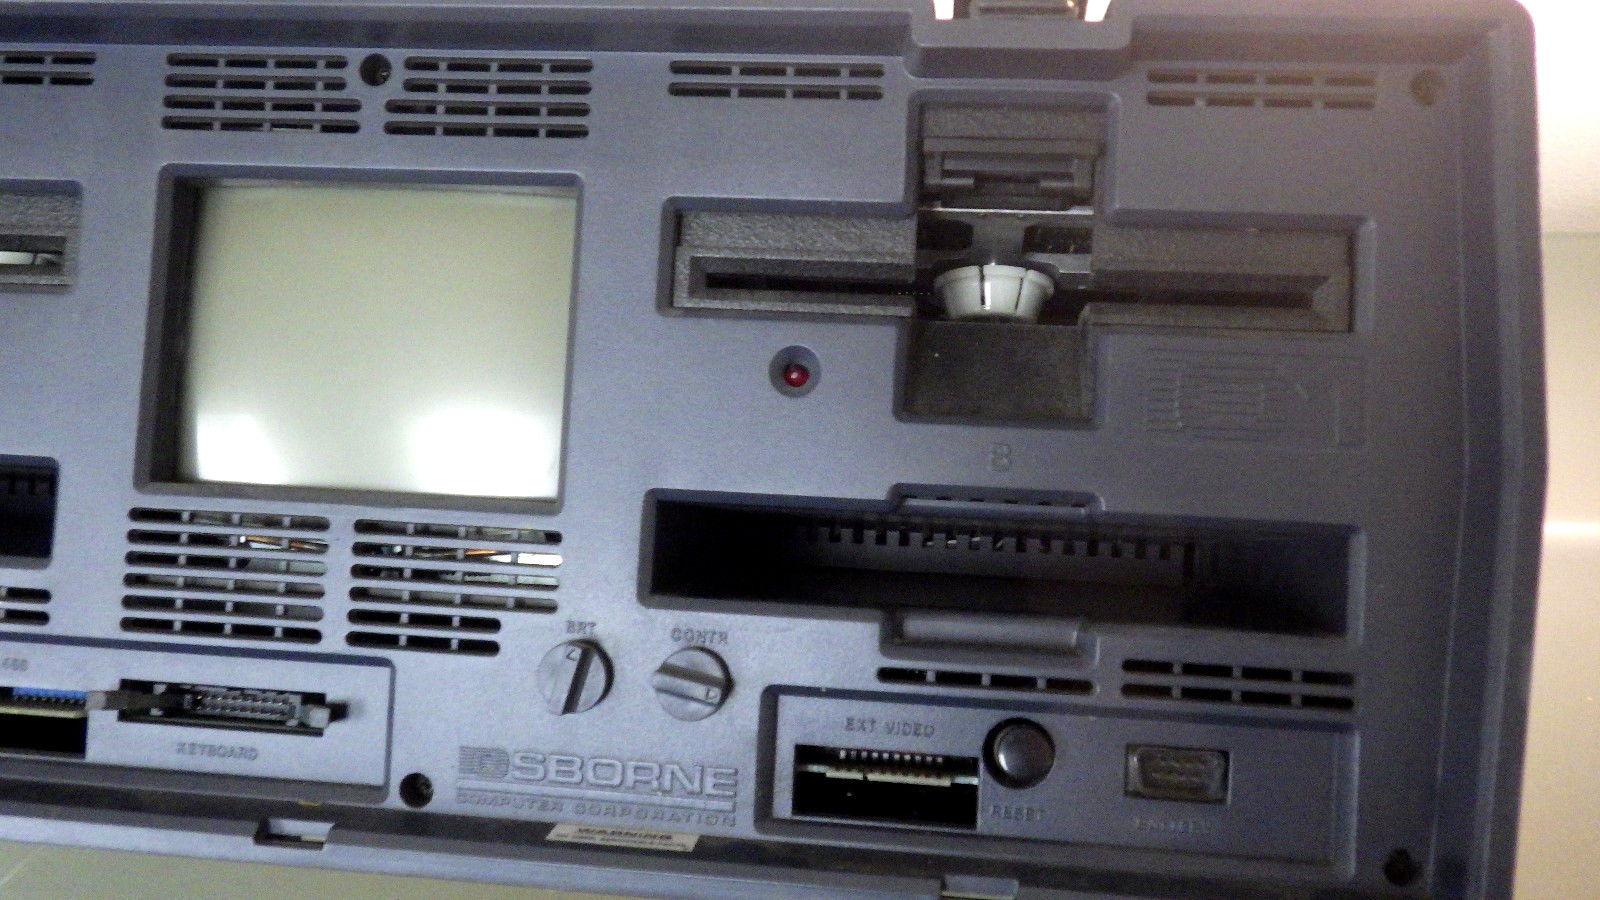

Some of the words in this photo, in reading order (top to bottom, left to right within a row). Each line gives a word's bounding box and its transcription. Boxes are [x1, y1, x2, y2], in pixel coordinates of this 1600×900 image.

[991, 443, 1012, 471] B
[565, 620, 598, 635] BRT
[670, 627, 729, 645] CONTR
[844, 716, 878, 733] EXT
[884, 719, 935, 738] VIDEO
[176, 741, 259, 761] KEYBOARD
[459, 746, 739, 798] OSBORNE
[457, 791, 564, 814] COMPUTER
[573, 799, 737, 828] CORPORATION
[991, 803, 1047, 822] RESET
